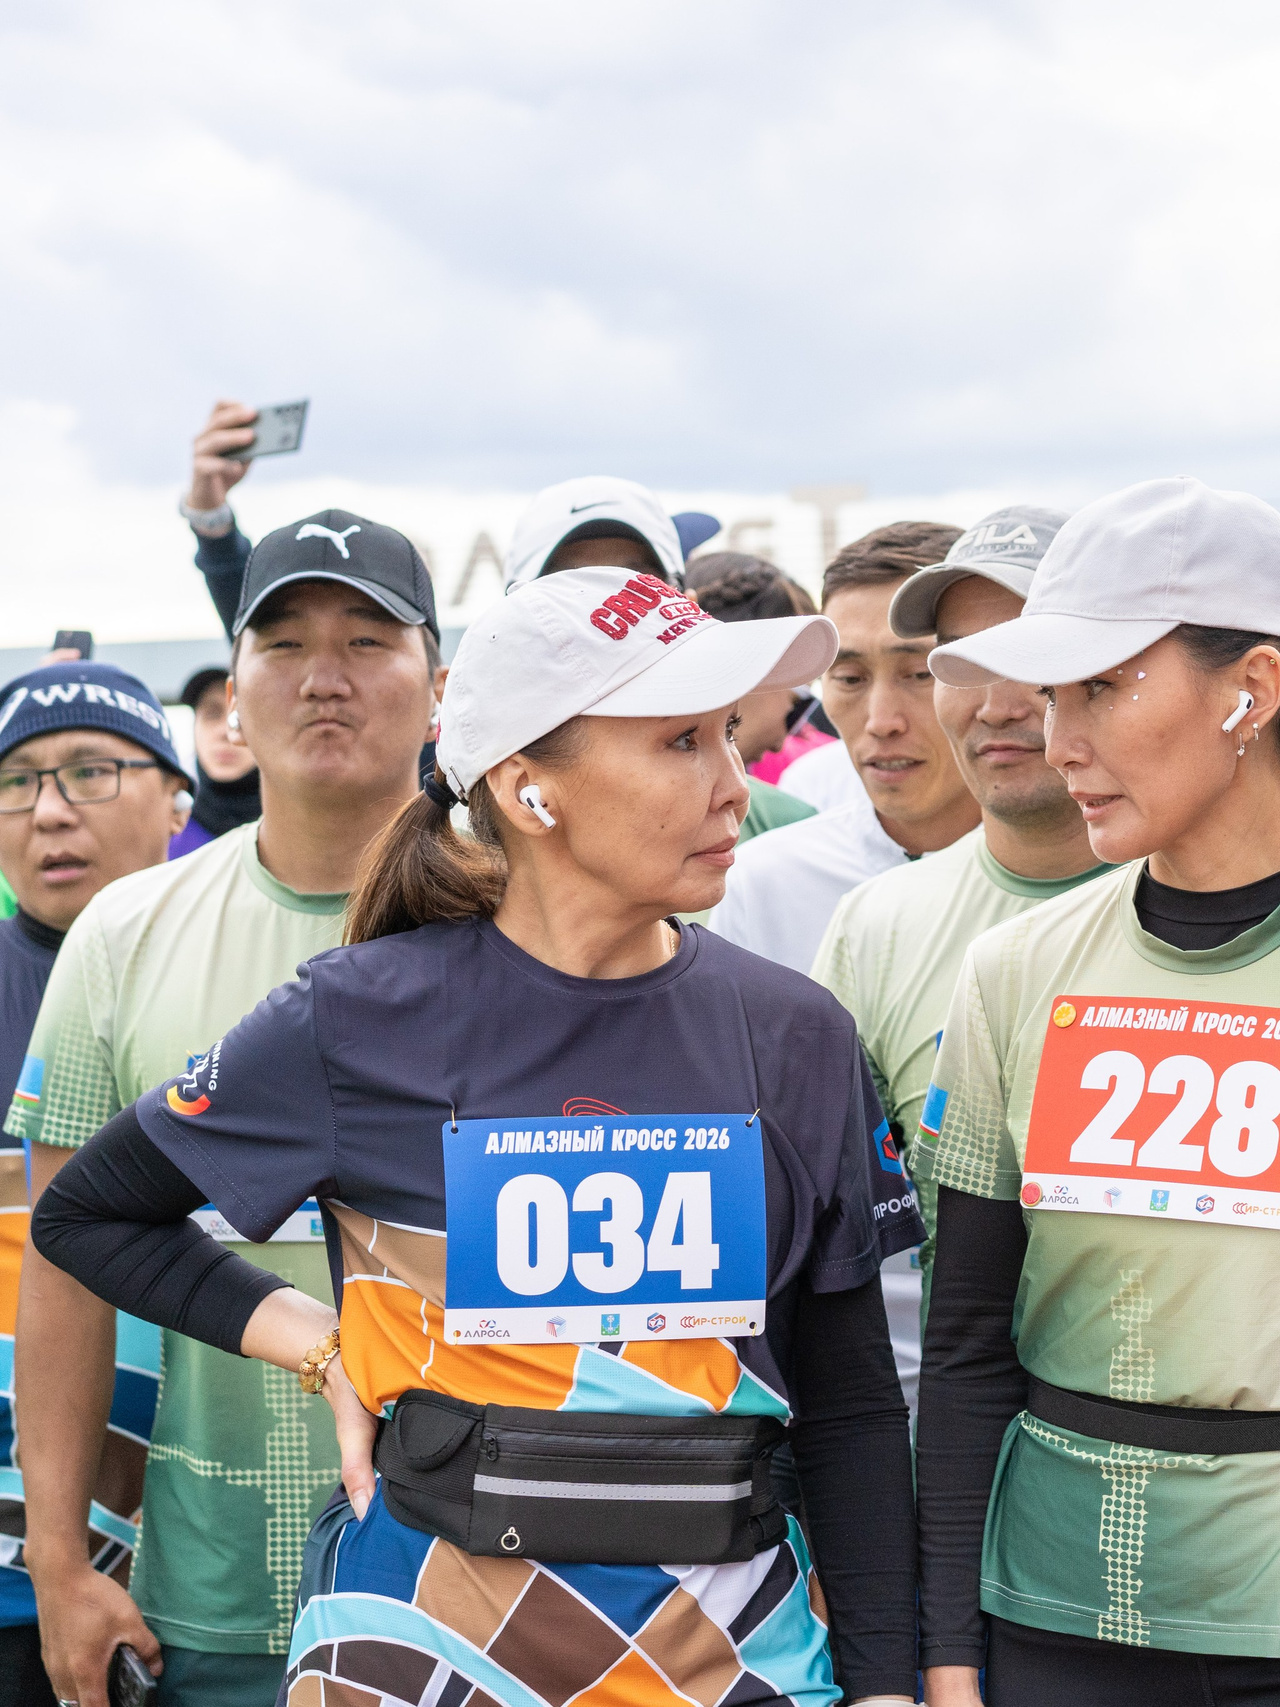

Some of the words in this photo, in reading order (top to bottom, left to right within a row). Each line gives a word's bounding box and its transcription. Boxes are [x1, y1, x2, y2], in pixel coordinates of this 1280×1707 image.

[957, 524, 1039, 549] FILA
[1079, 1006, 1188, 1031] АЛМАЗНЫЙ
[1192, 1010, 1255, 1038] КРОСС
[484, 1125, 604, 1154] АЛМАЗНЫЙ
[611, 1128, 677, 1152] КРОСС
[683, 1128, 730, 1150] 2026
[496, 1171, 720, 1296] 034
